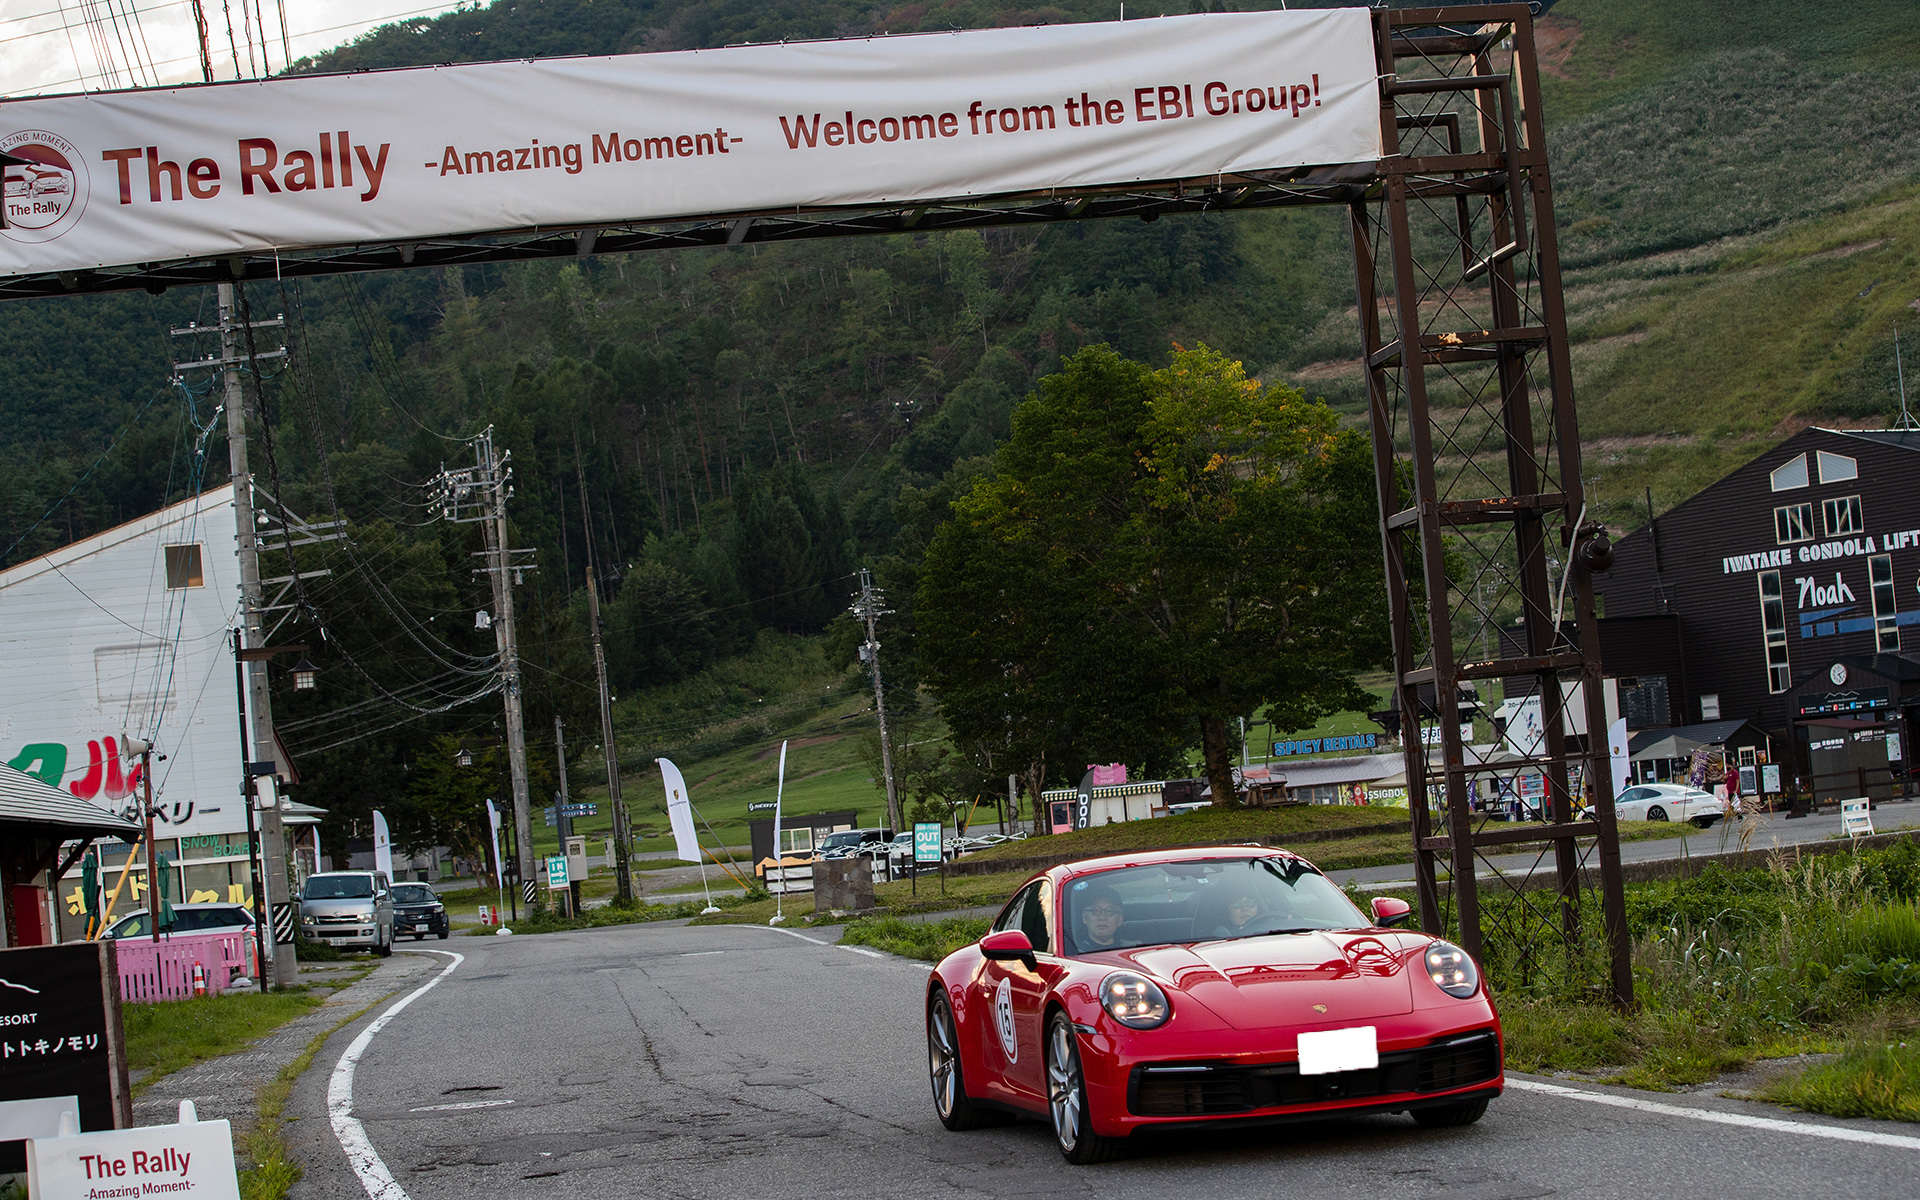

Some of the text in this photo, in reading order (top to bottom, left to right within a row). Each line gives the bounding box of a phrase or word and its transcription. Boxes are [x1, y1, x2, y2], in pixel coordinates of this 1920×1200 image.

[779, 73, 1322, 149] Welcome from the EBI Group!
[32, 132, 73, 154] MOMENT
[424, 127, 744, 176] -Amazing Moment-
[102, 130, 391, 205] The Rally
[8, 200, 62, 217] The Rally
[1722, 548, 1792, 575] IWATAKE
[1798, 536, 1877, 563] GONDOLA
[1794, 571, 1857, 610] Noah
[1274, 733, 1376, 756] SPICY RENTALS
[182, 834, 221, 850] SNOW
[916, 831, 939, 842] OUT
[998, 1002, 1012, 1037] 15
[79, 1147, 191, 1180] The Rally
[83, 1179, 196, 1200] -Amazing Moment-
